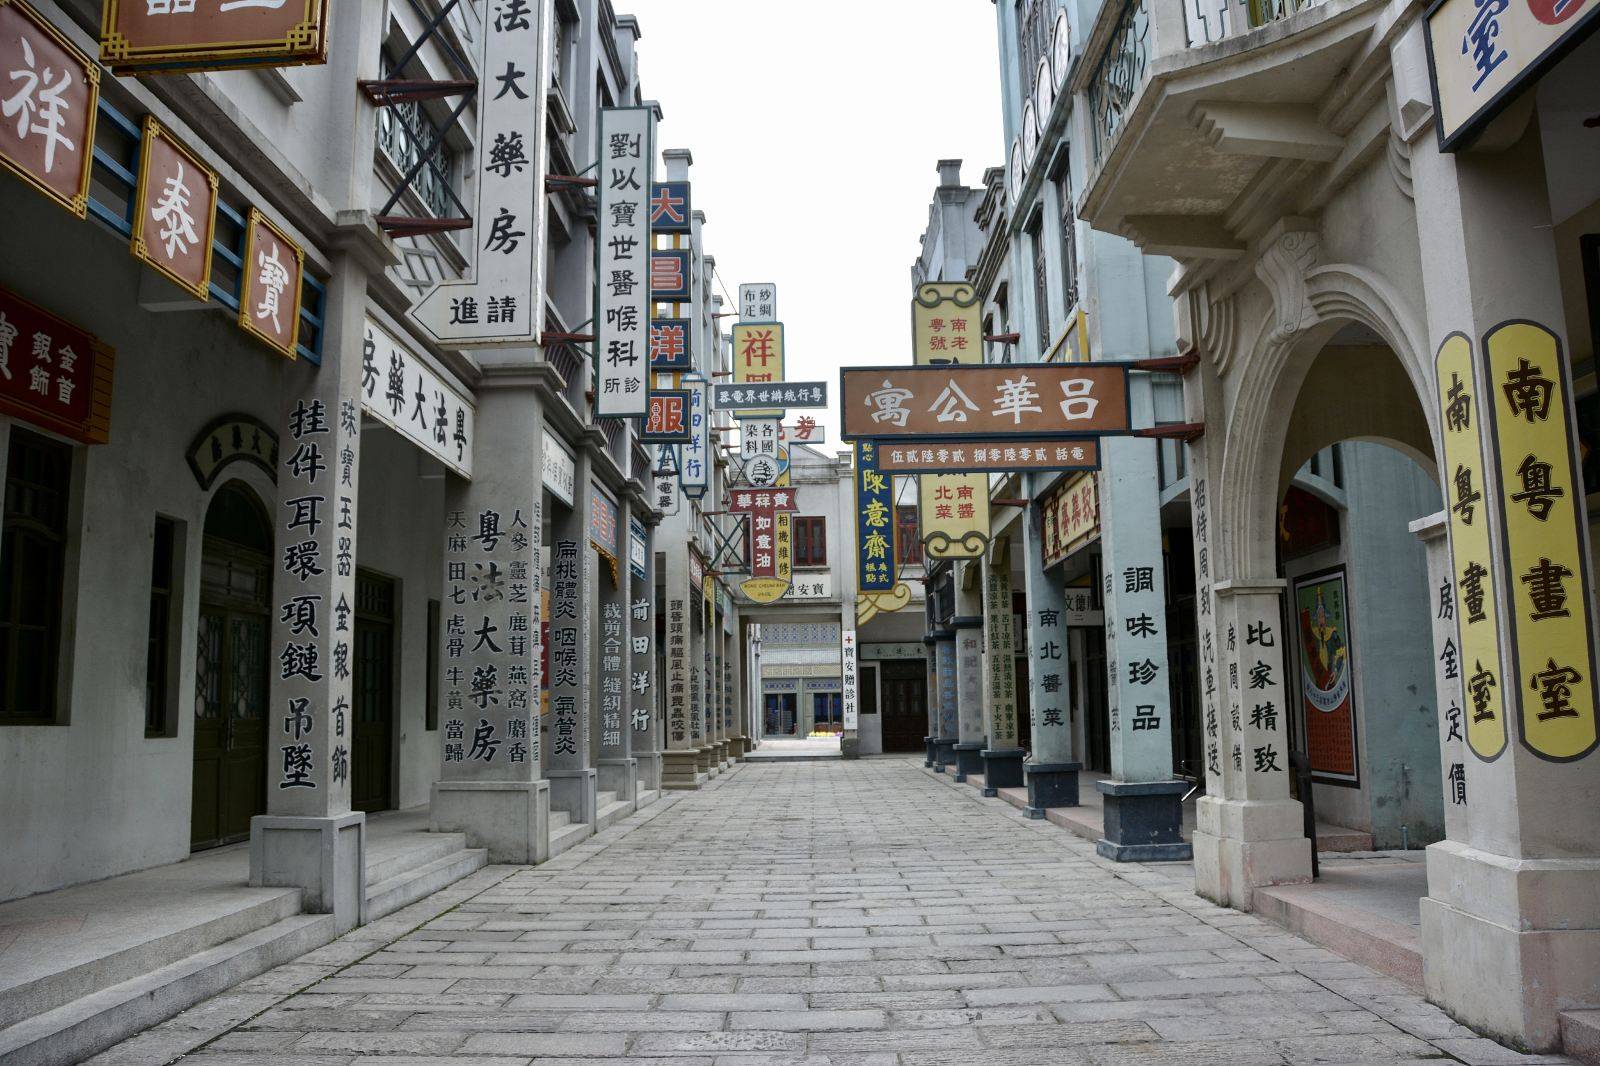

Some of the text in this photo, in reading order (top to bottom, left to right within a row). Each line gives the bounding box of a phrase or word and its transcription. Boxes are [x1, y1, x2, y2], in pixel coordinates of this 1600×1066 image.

[450, 296, 516, 325] 請進
[864, 375, 1099, 427] 呂華公寓
[284, 496, 325, 582] 耳環
[1123, 566, 1161, 731] 調味珍品
[1437, 576, 1467, 807] 房金定價
